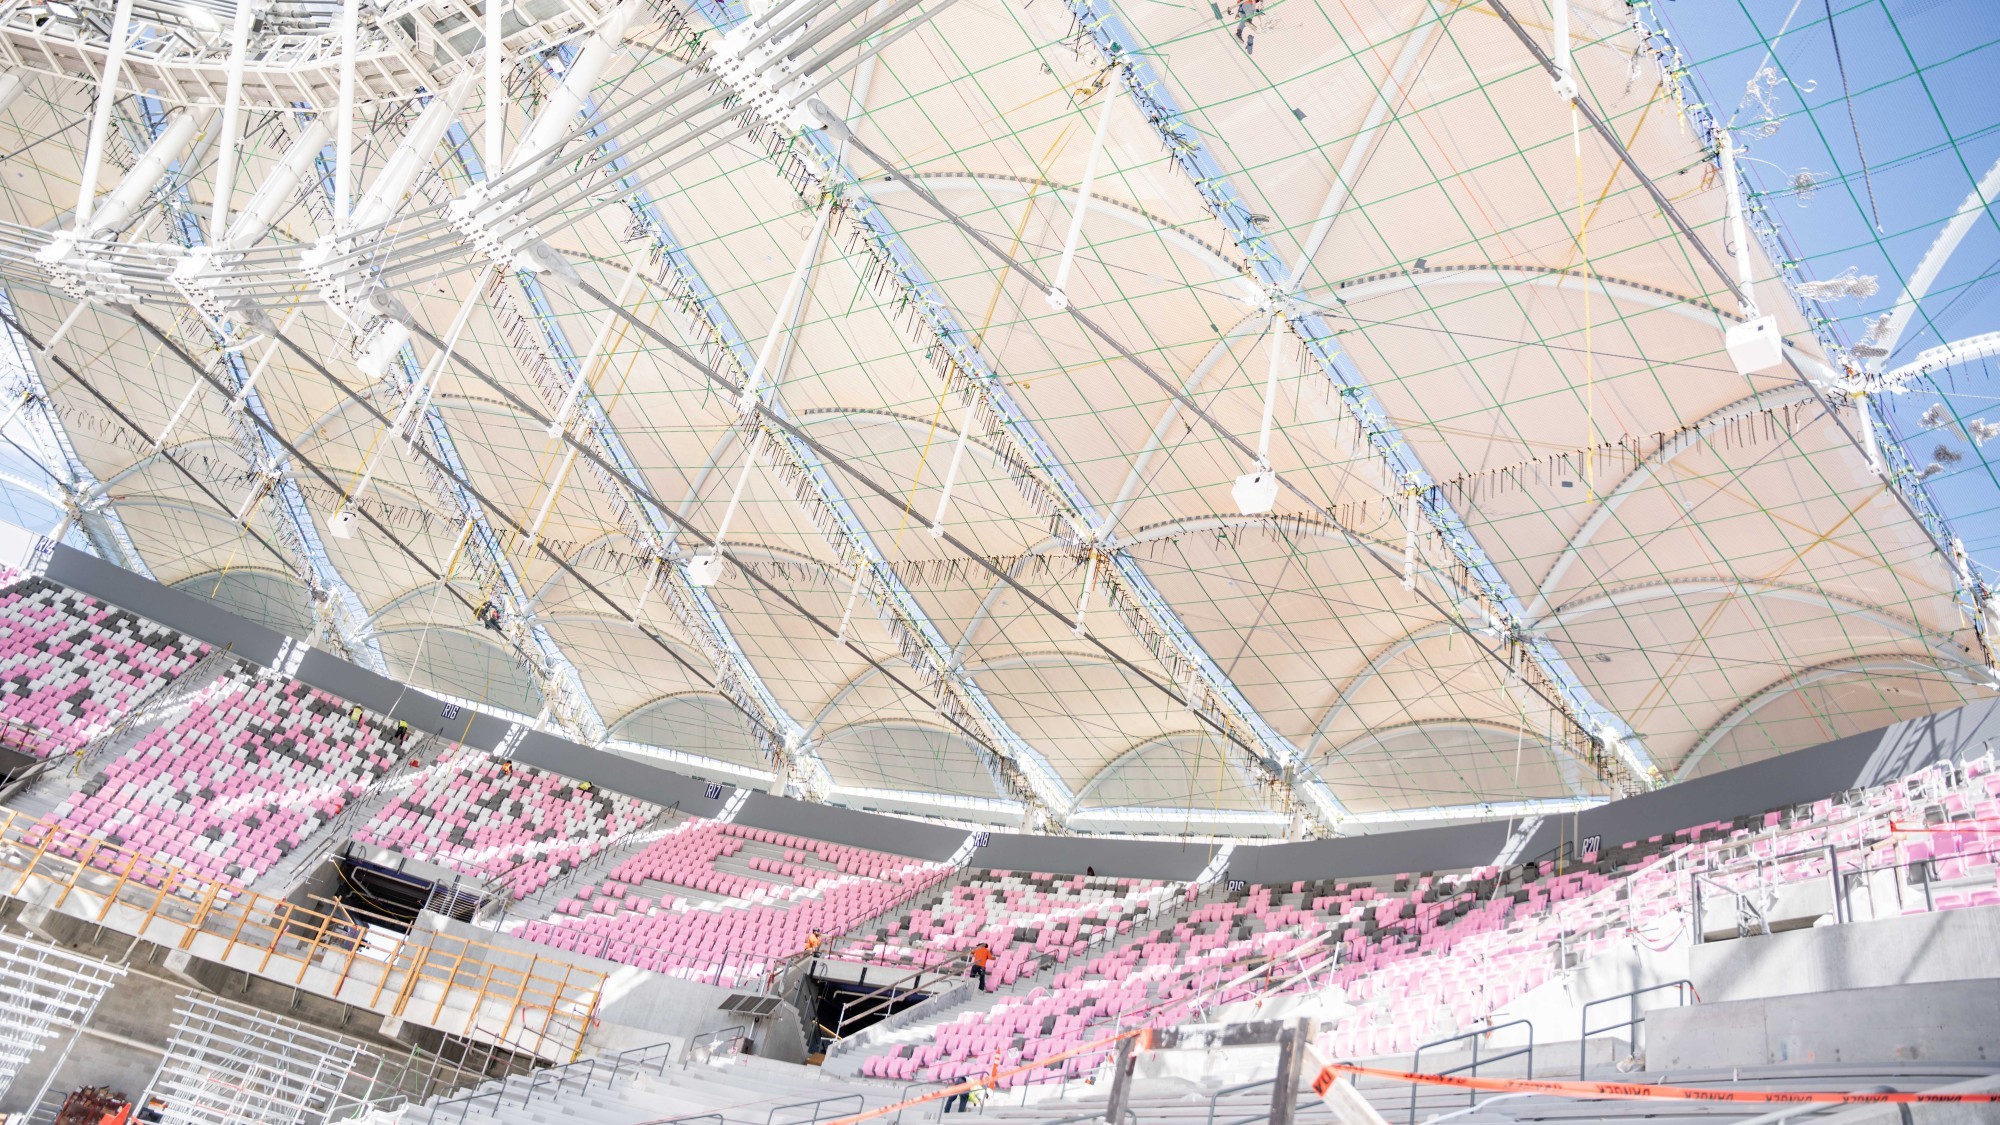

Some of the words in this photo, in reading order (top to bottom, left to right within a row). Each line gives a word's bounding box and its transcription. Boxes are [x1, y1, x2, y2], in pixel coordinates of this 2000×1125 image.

[35, 536, 57, 554] R14
[442, 703, 459, 719] R16
[705, 784, 721, 799] R17
[974, 832, 989, 847] R18
[1581, 835, 1600, 857] R20
